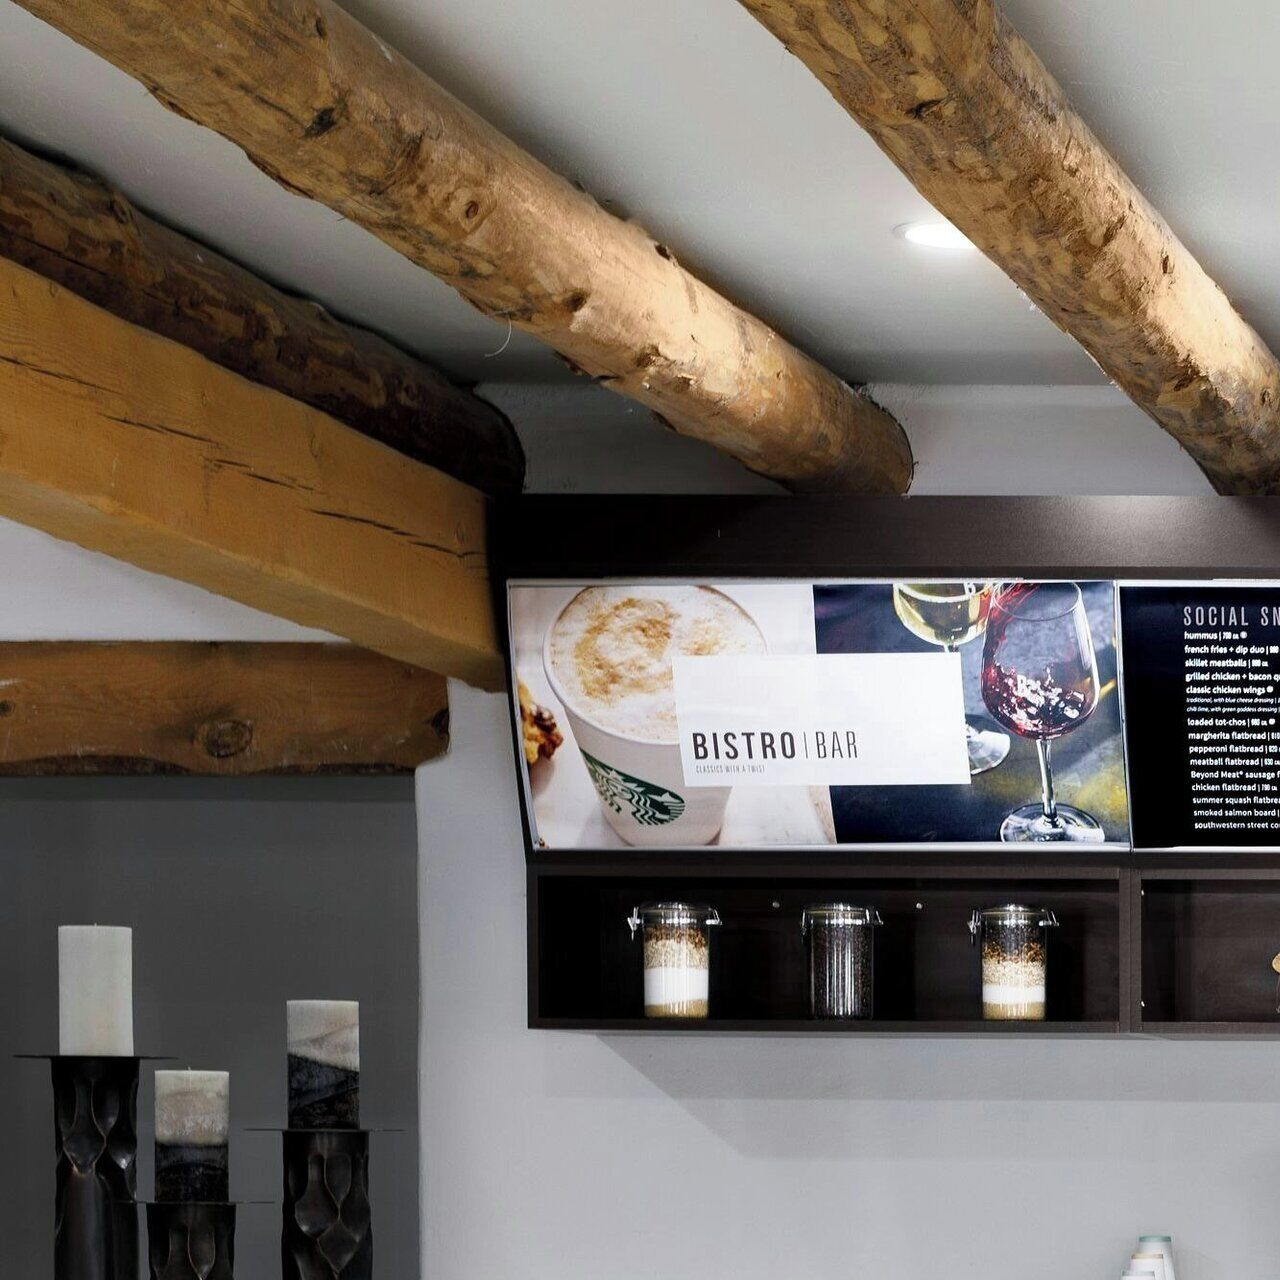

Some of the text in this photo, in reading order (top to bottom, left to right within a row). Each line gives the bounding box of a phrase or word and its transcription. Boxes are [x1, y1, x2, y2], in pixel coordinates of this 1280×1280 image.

[1184, 606, 1248, 625] SOCIAL
[1183, 630, 1218, 640] hummus
[1188, 730, 1267, 742] margherita flatbread
[692, 731, 858, 760] BISTRO BAR
[1189, 757, 1260, 766] meatball flatbread
[696, 765, 723, 774] CLASSICS
[725, 765, 740, 774] WITH
[748, 765, 765, 774] TWIST
[1190, 770, 1220, 780] Beyond
[1244, 771, 1276, 781] sausage
[1191, 782, 1257, 792] chicken flatbread
[1224, 795, 1252, 806] squash
[1193, 808, 1277, 817] smoked salmon board
[1194, 821, 1246, 830] southwestern
[1246, 821, 1269, 829] street
